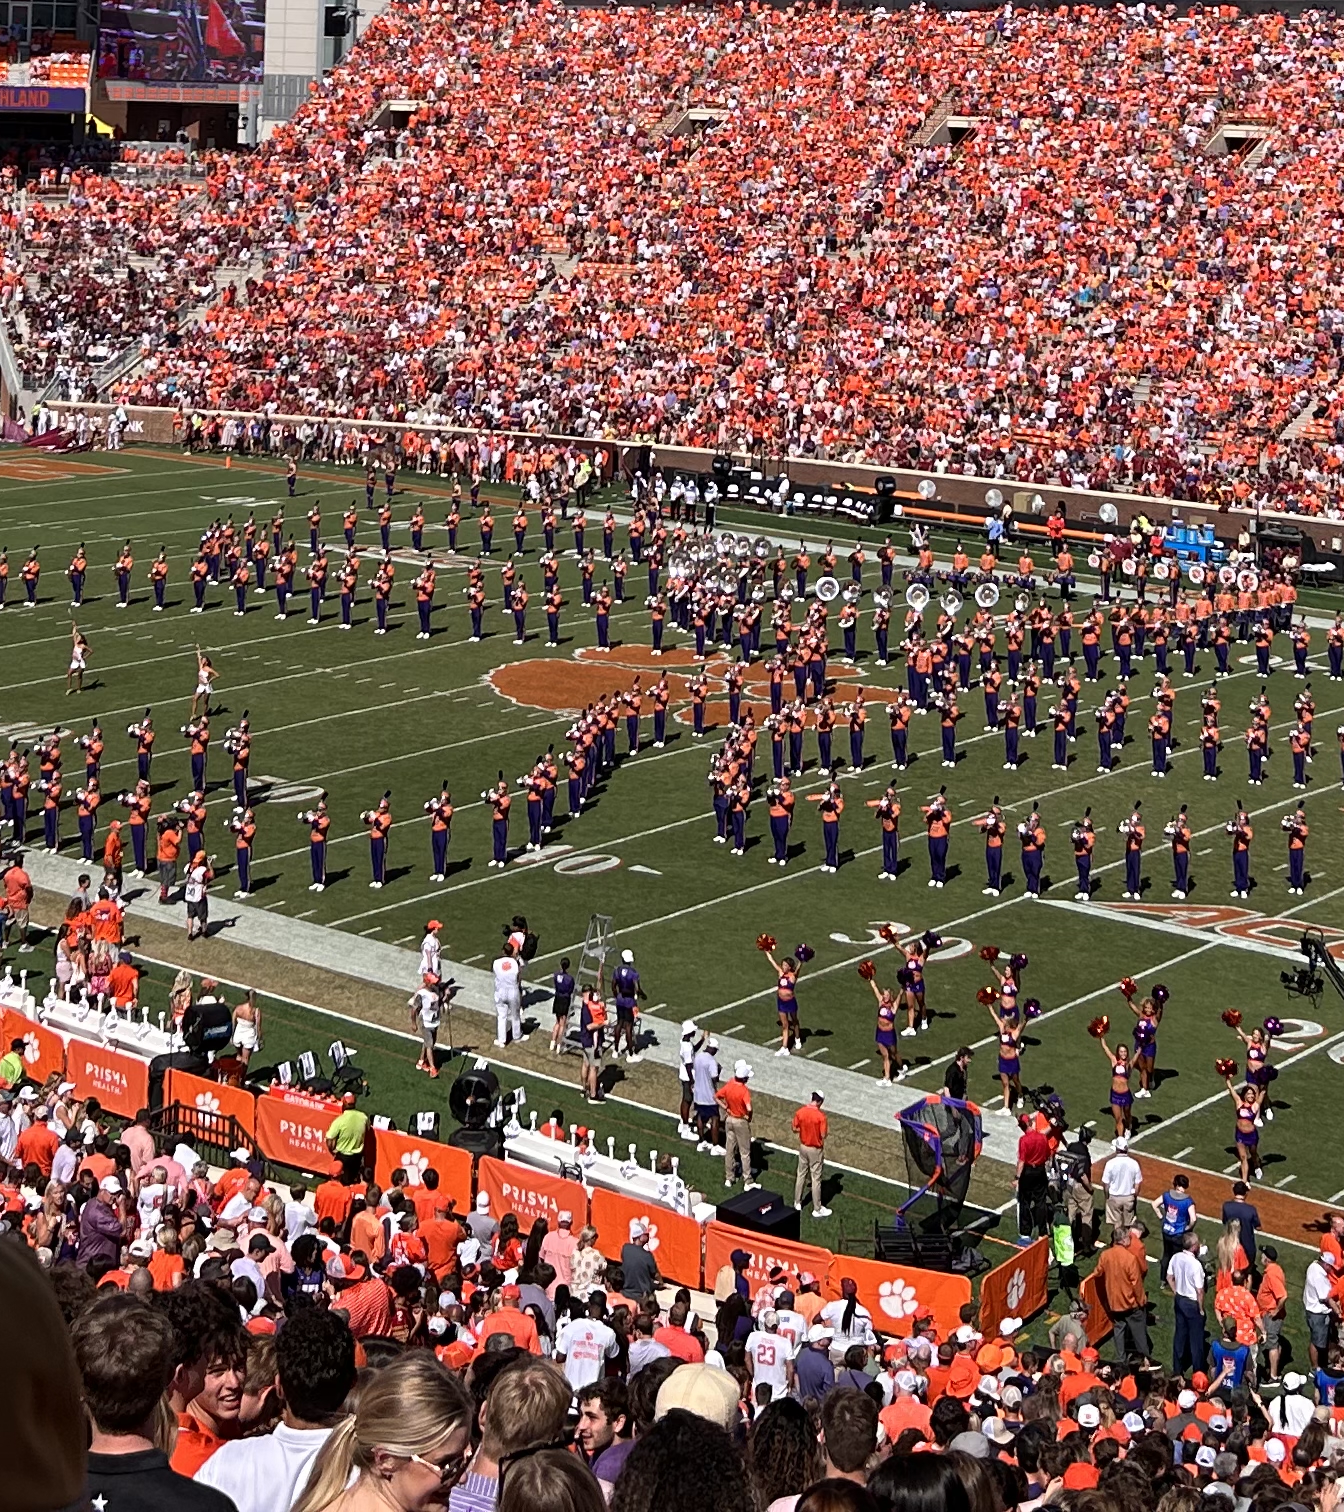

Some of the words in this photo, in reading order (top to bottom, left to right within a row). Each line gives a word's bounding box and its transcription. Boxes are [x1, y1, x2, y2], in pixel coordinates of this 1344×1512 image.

[85, 1061, 128, 1088] PRISMA
[280, 1119, 327, 1144] PRISM
[502, 1182, 559, 1214] PRISMA
[747, 1251, 800, 1276] RISMA
[757, 1344, 776, 1367] 23
